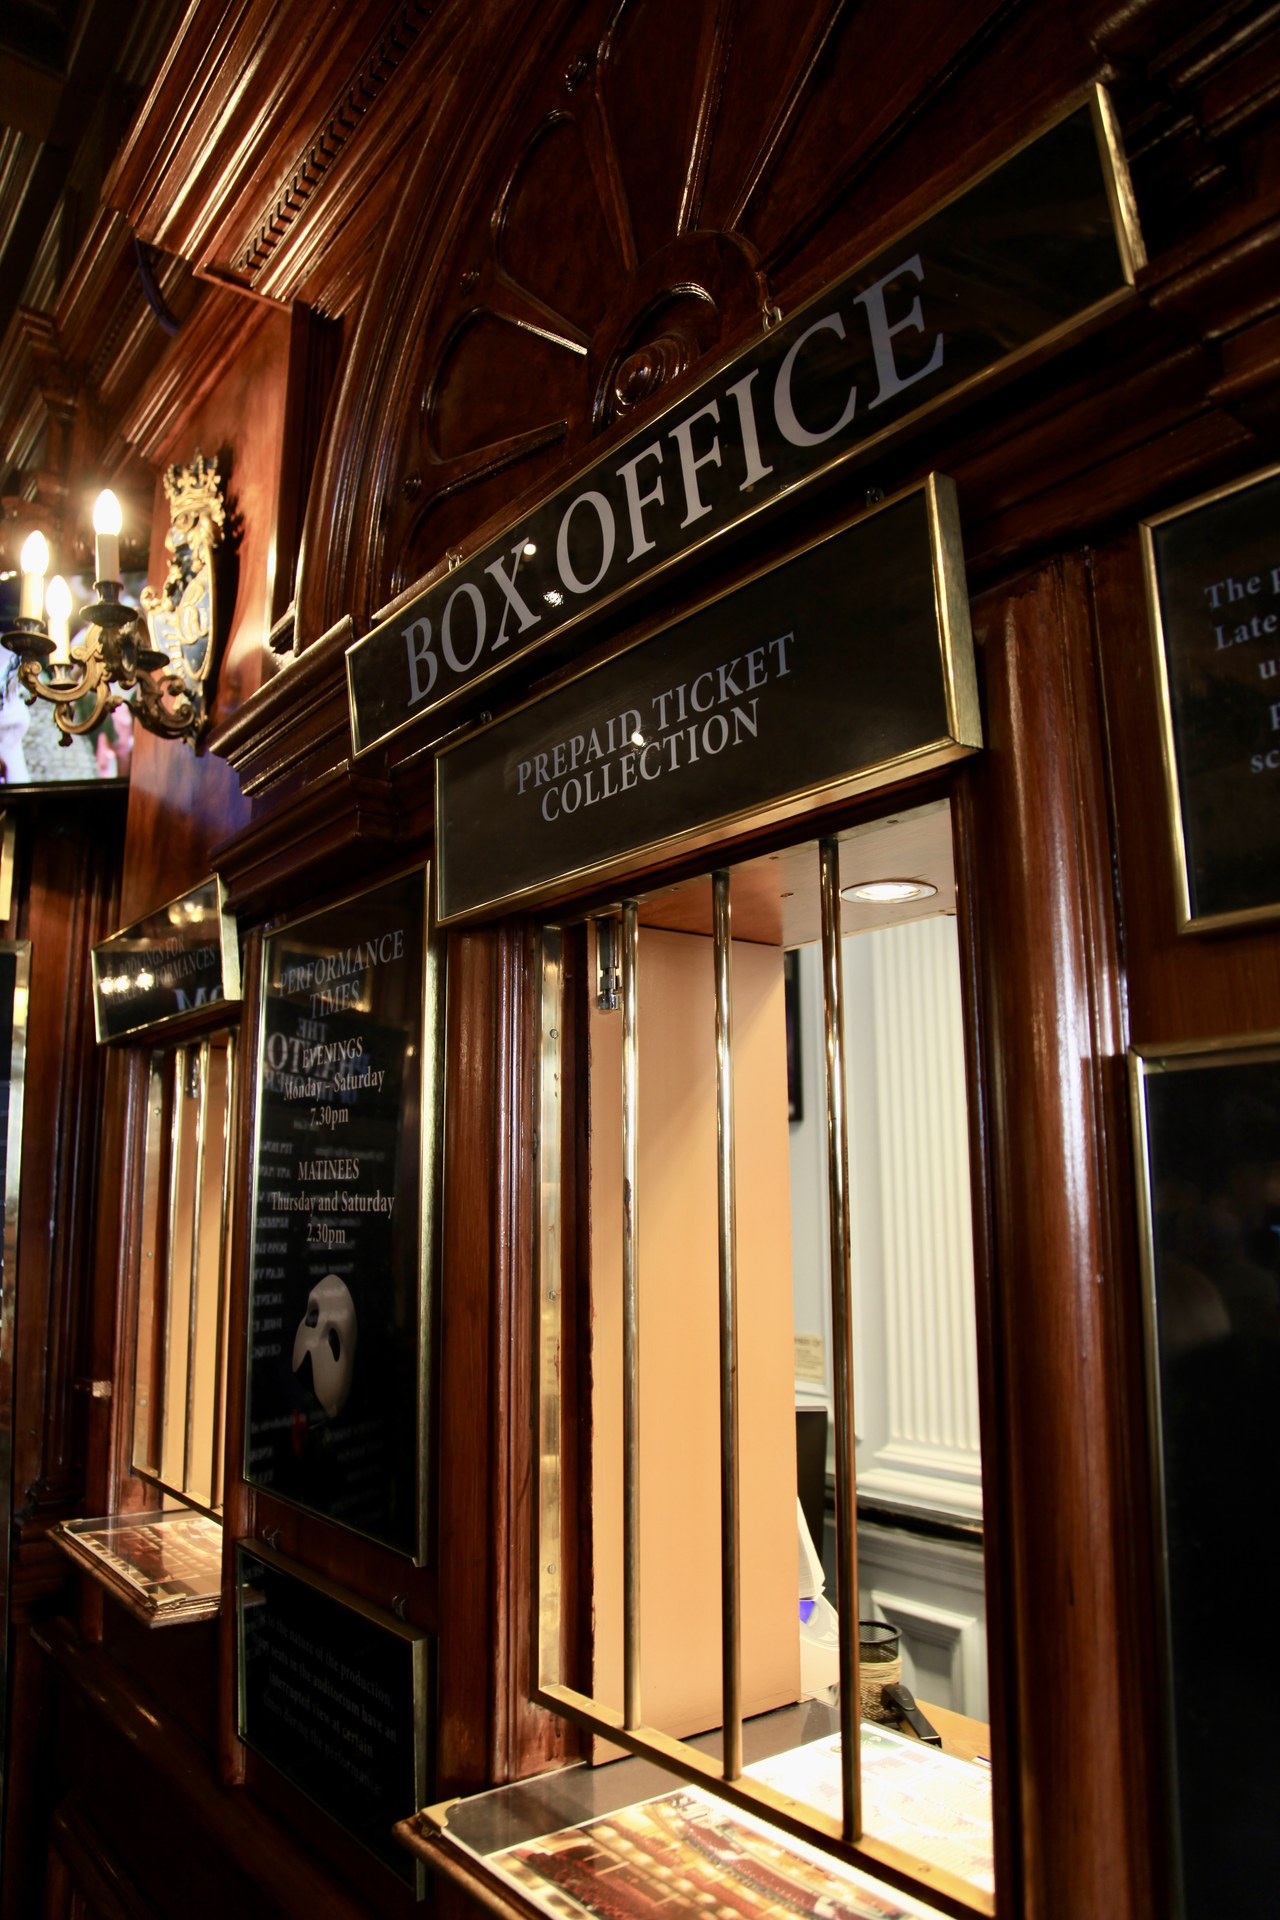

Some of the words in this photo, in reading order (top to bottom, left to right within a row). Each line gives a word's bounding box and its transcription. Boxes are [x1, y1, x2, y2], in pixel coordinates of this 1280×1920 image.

[401, 536, 541, 707] BOX
[556, 253, 943, 594] OFFICE
[1204, 576, 1261, 611] The
[517, 708, 644, 795] PREPAID
[652, 631, 795, 731] TICKET
[541, 698, 760, 822] COLLECTION
[280, 929, 404, 998] PERFORMANCE
[309, 979, 361, 1019] TIMES
[302, 1035, 363, 1069] EVENINGS
[283, 1077, 322, 1102] Monday
[334, 1066, 385, 1093] Saturday
[310, 1105, 349, 1131] 7.30pm
[298, 1158, 359, 1181] MATINEES
[271, 1190, 317, 1217] Thursday
[318, 1189, 338, 1212] and
[341, 1189, 395, 1220] Saturday
[306, 1222, 346, 1250] 2.30pm
